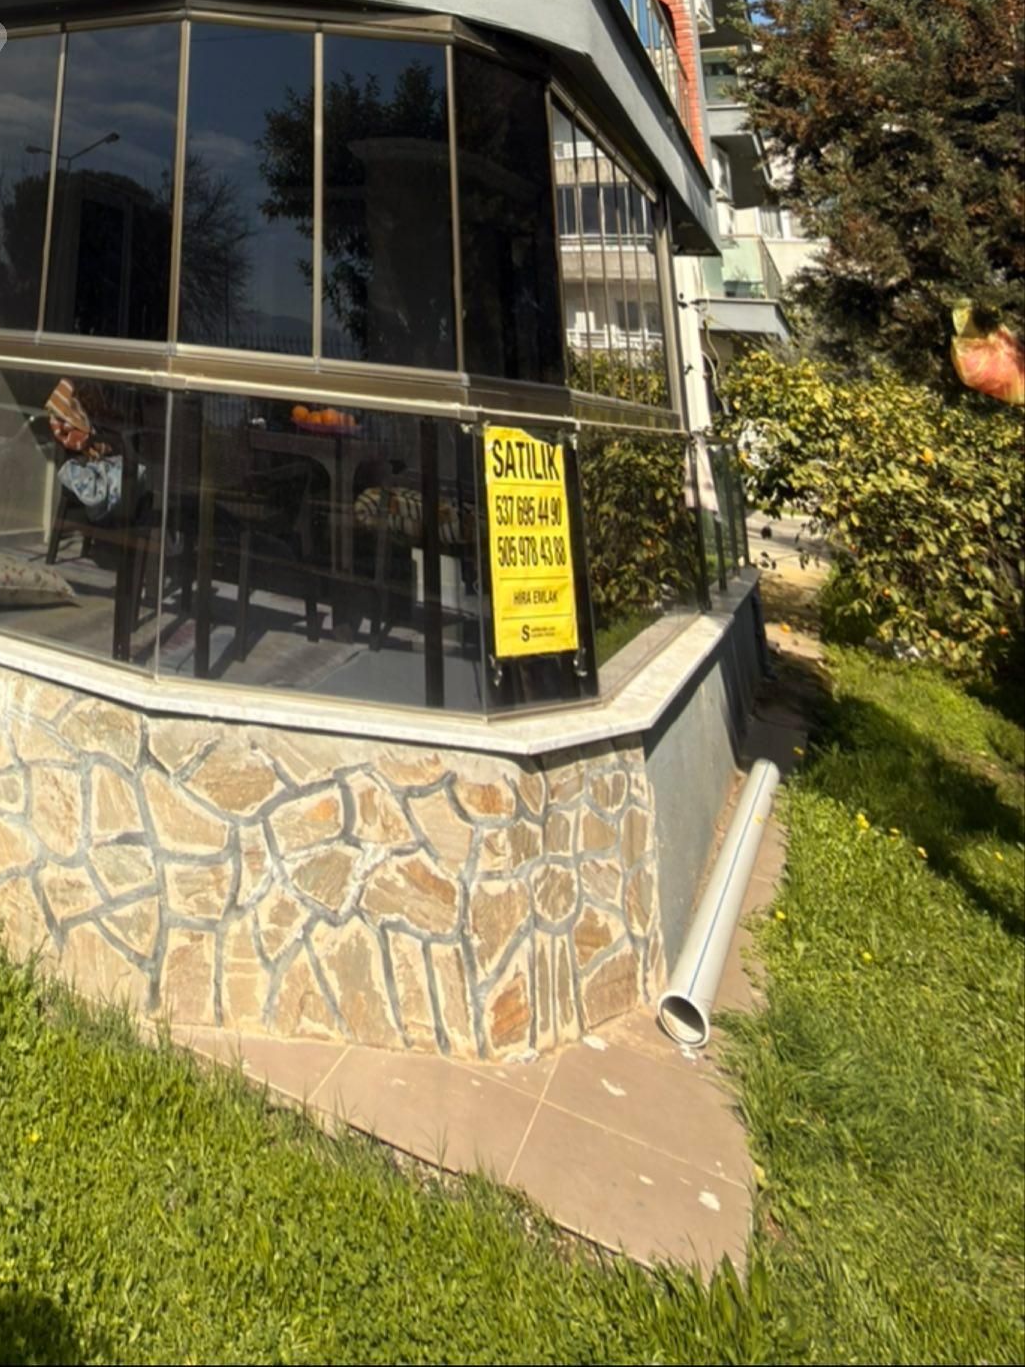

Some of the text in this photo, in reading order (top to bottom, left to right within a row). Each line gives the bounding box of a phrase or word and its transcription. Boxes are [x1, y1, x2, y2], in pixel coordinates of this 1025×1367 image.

[492, 438, 561, 481] SATILIK
[495, 495, 562, 527] 537 695 44 90
[497, 536, 567, 567] 505 978 43 88
[533, 590, 558, 604] EMLAK
